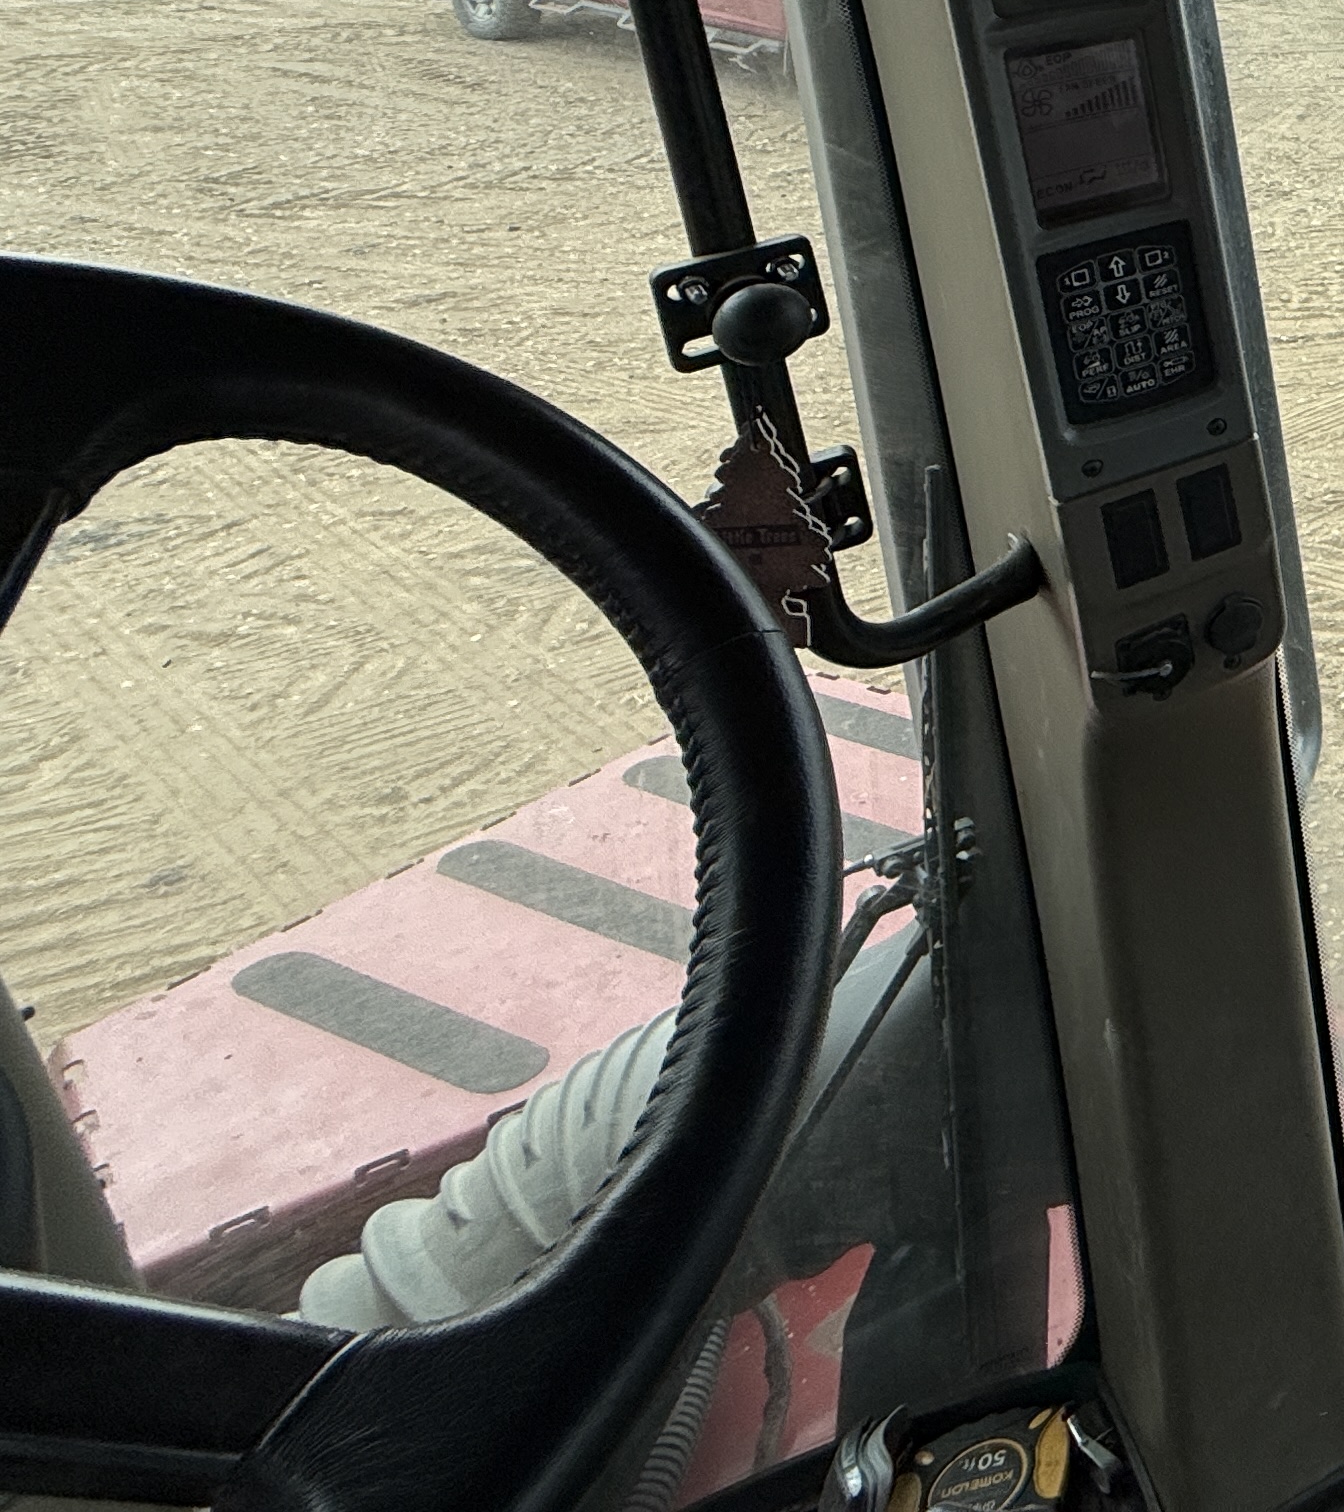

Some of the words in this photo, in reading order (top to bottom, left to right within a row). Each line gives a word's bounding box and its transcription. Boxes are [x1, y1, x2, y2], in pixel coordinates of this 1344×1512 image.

[1046, 52, 1072, 66] EOP
[1037, 182, 1072, 199] ECON
[1149, 285, 1178, 298] RESET
[1068, 306, 1100, 320] PROG
[1161, 341, 1188, 355] AREA
[1123, 353, 1146, 366] DIST
[1082, 362, 1109, 378] PERF
[1163, 364, 1186, 377] EHR
[1126, 379, 1156, 394] AUTO
[941, 1469, 1014, 1498] KOMELON
